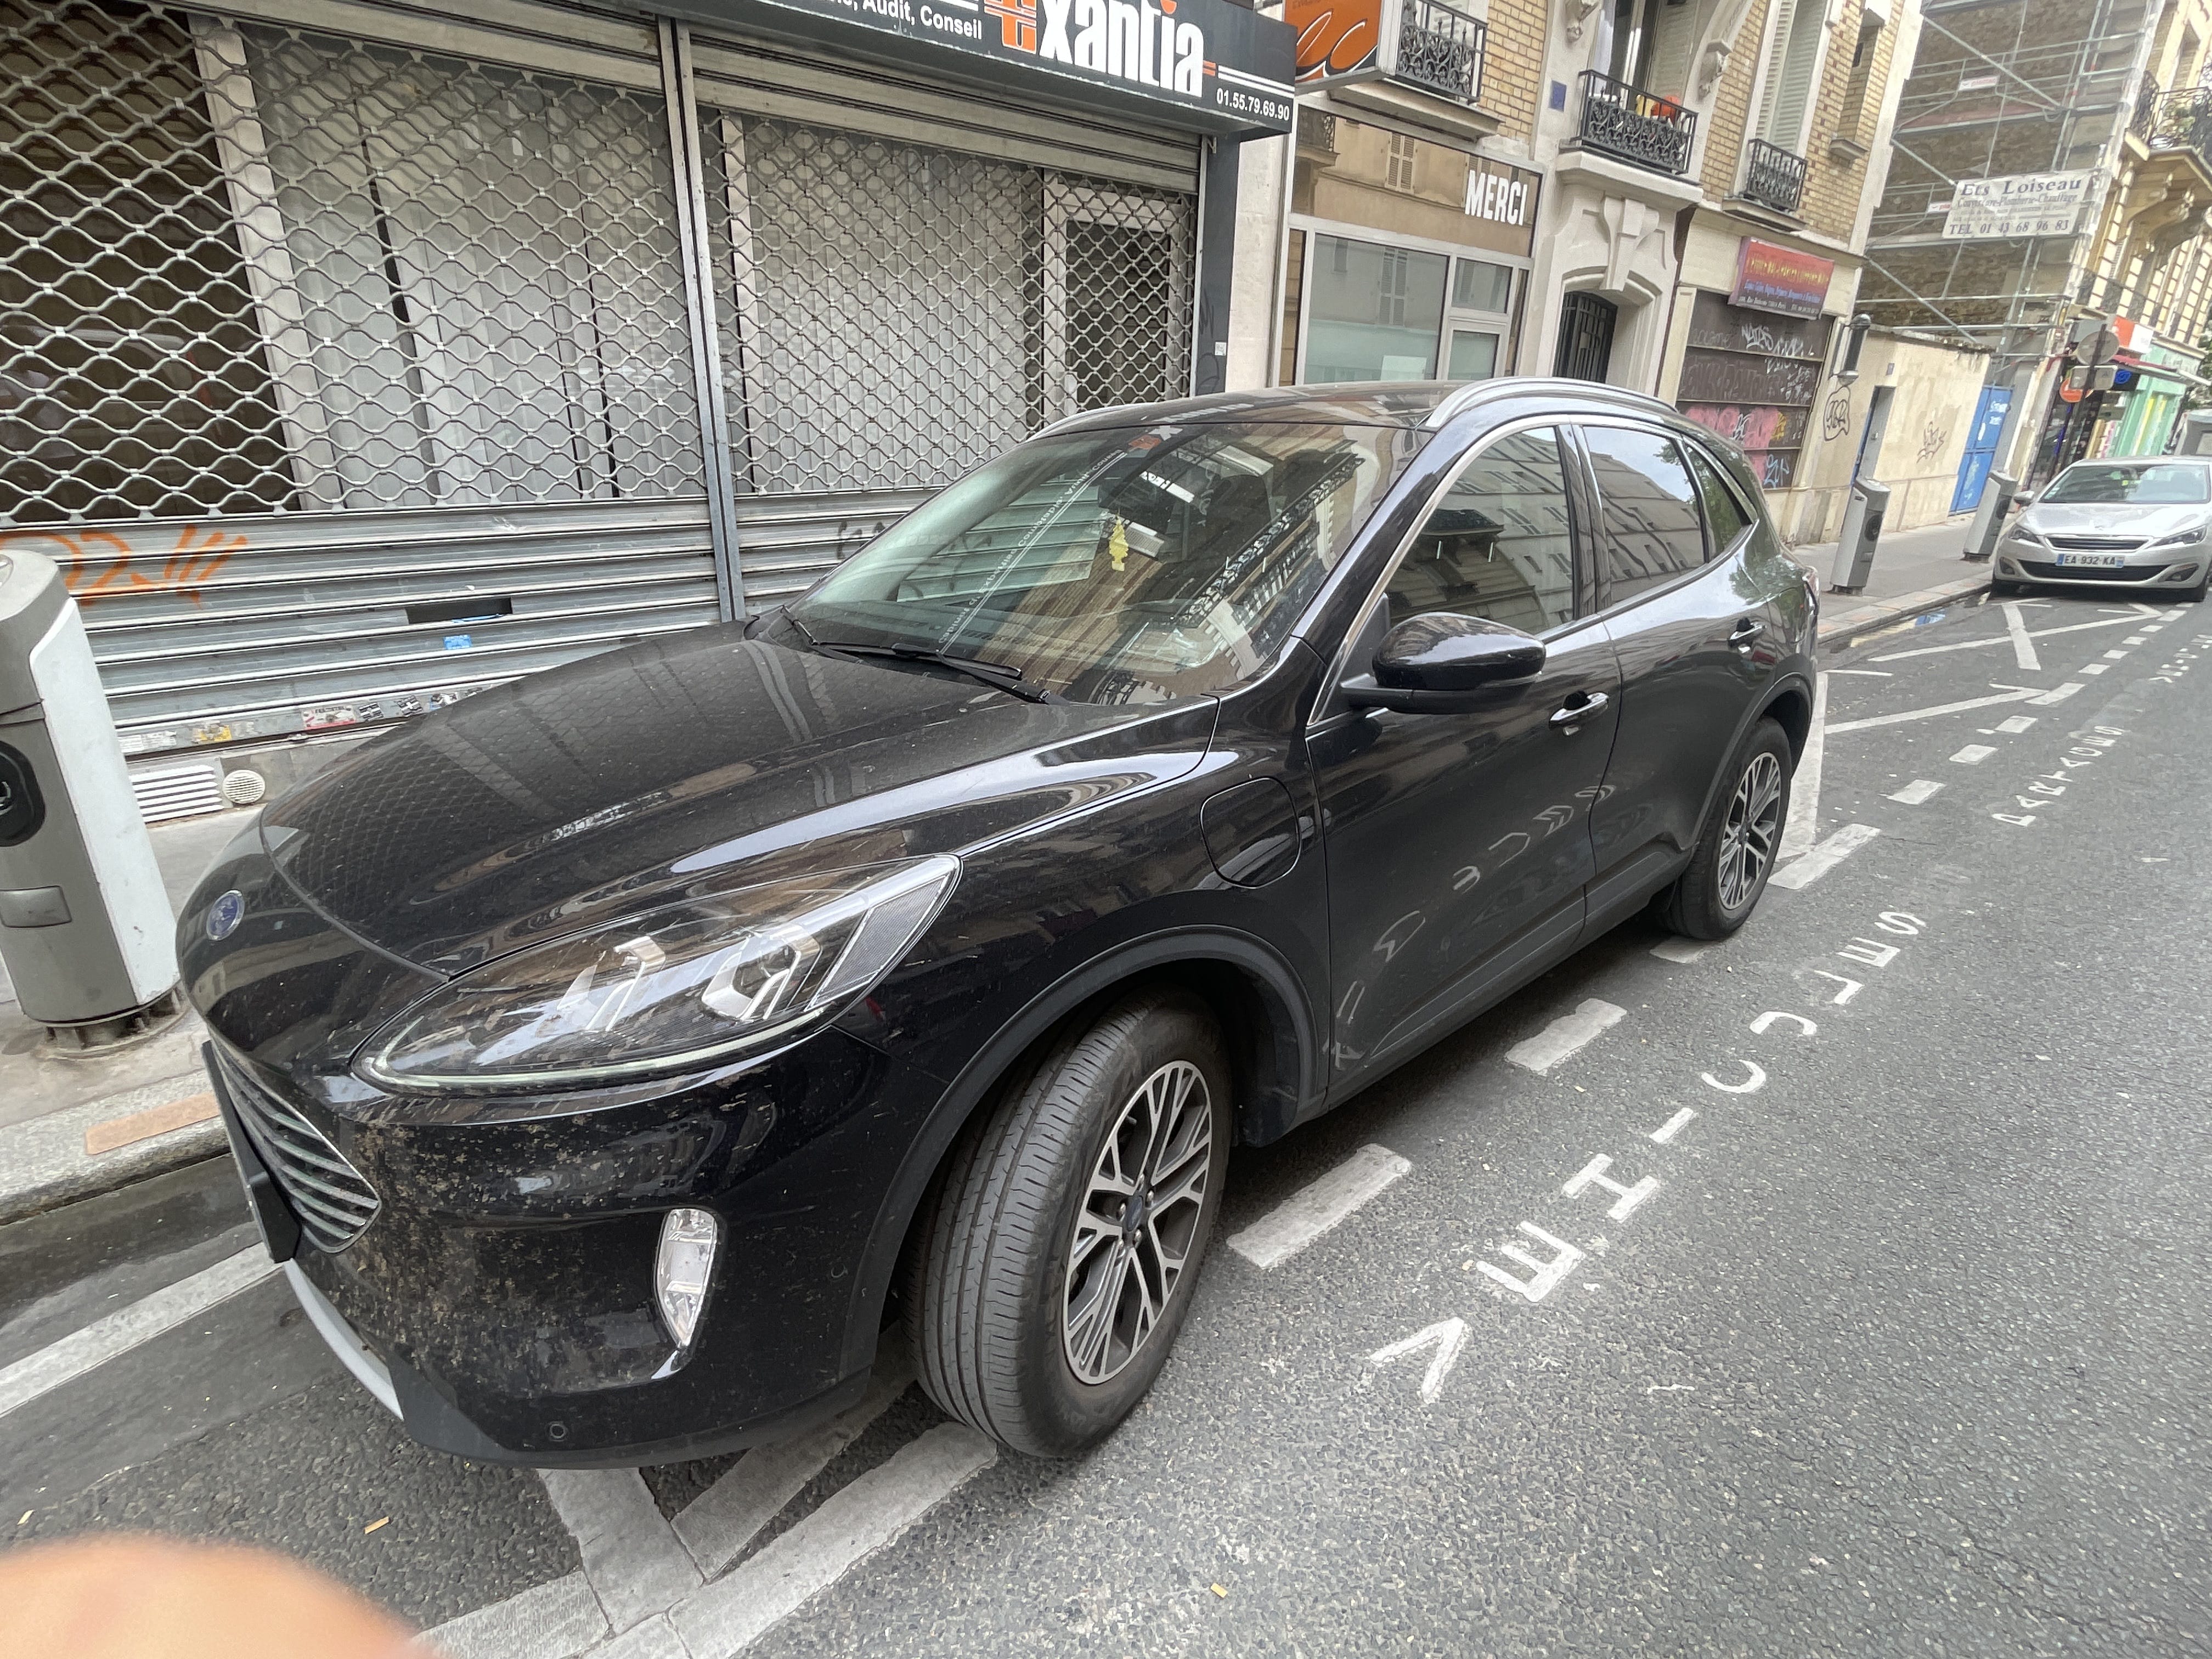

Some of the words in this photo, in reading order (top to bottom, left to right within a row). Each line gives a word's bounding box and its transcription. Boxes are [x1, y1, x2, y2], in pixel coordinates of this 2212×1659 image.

[920, 8, 983, 40] Conseil
[1215, 87, 1290, 121] 01.55.79.69.90
[1465, 170, 1528, 226] MERCI
[1961, 183, 1989, 196] Ets
[2003, 178, 2081, 195] Loiseau
[1949, 224, 1973, 235] TEL
[1979, 223, 1992, 234] 01
[2016, 221, 2030, 233] 68
[2036, 221, 2049, 232] 96
[2055, 219, 2069, 231] 83
[1370, 909, 1926, 1404] VEHICULES
